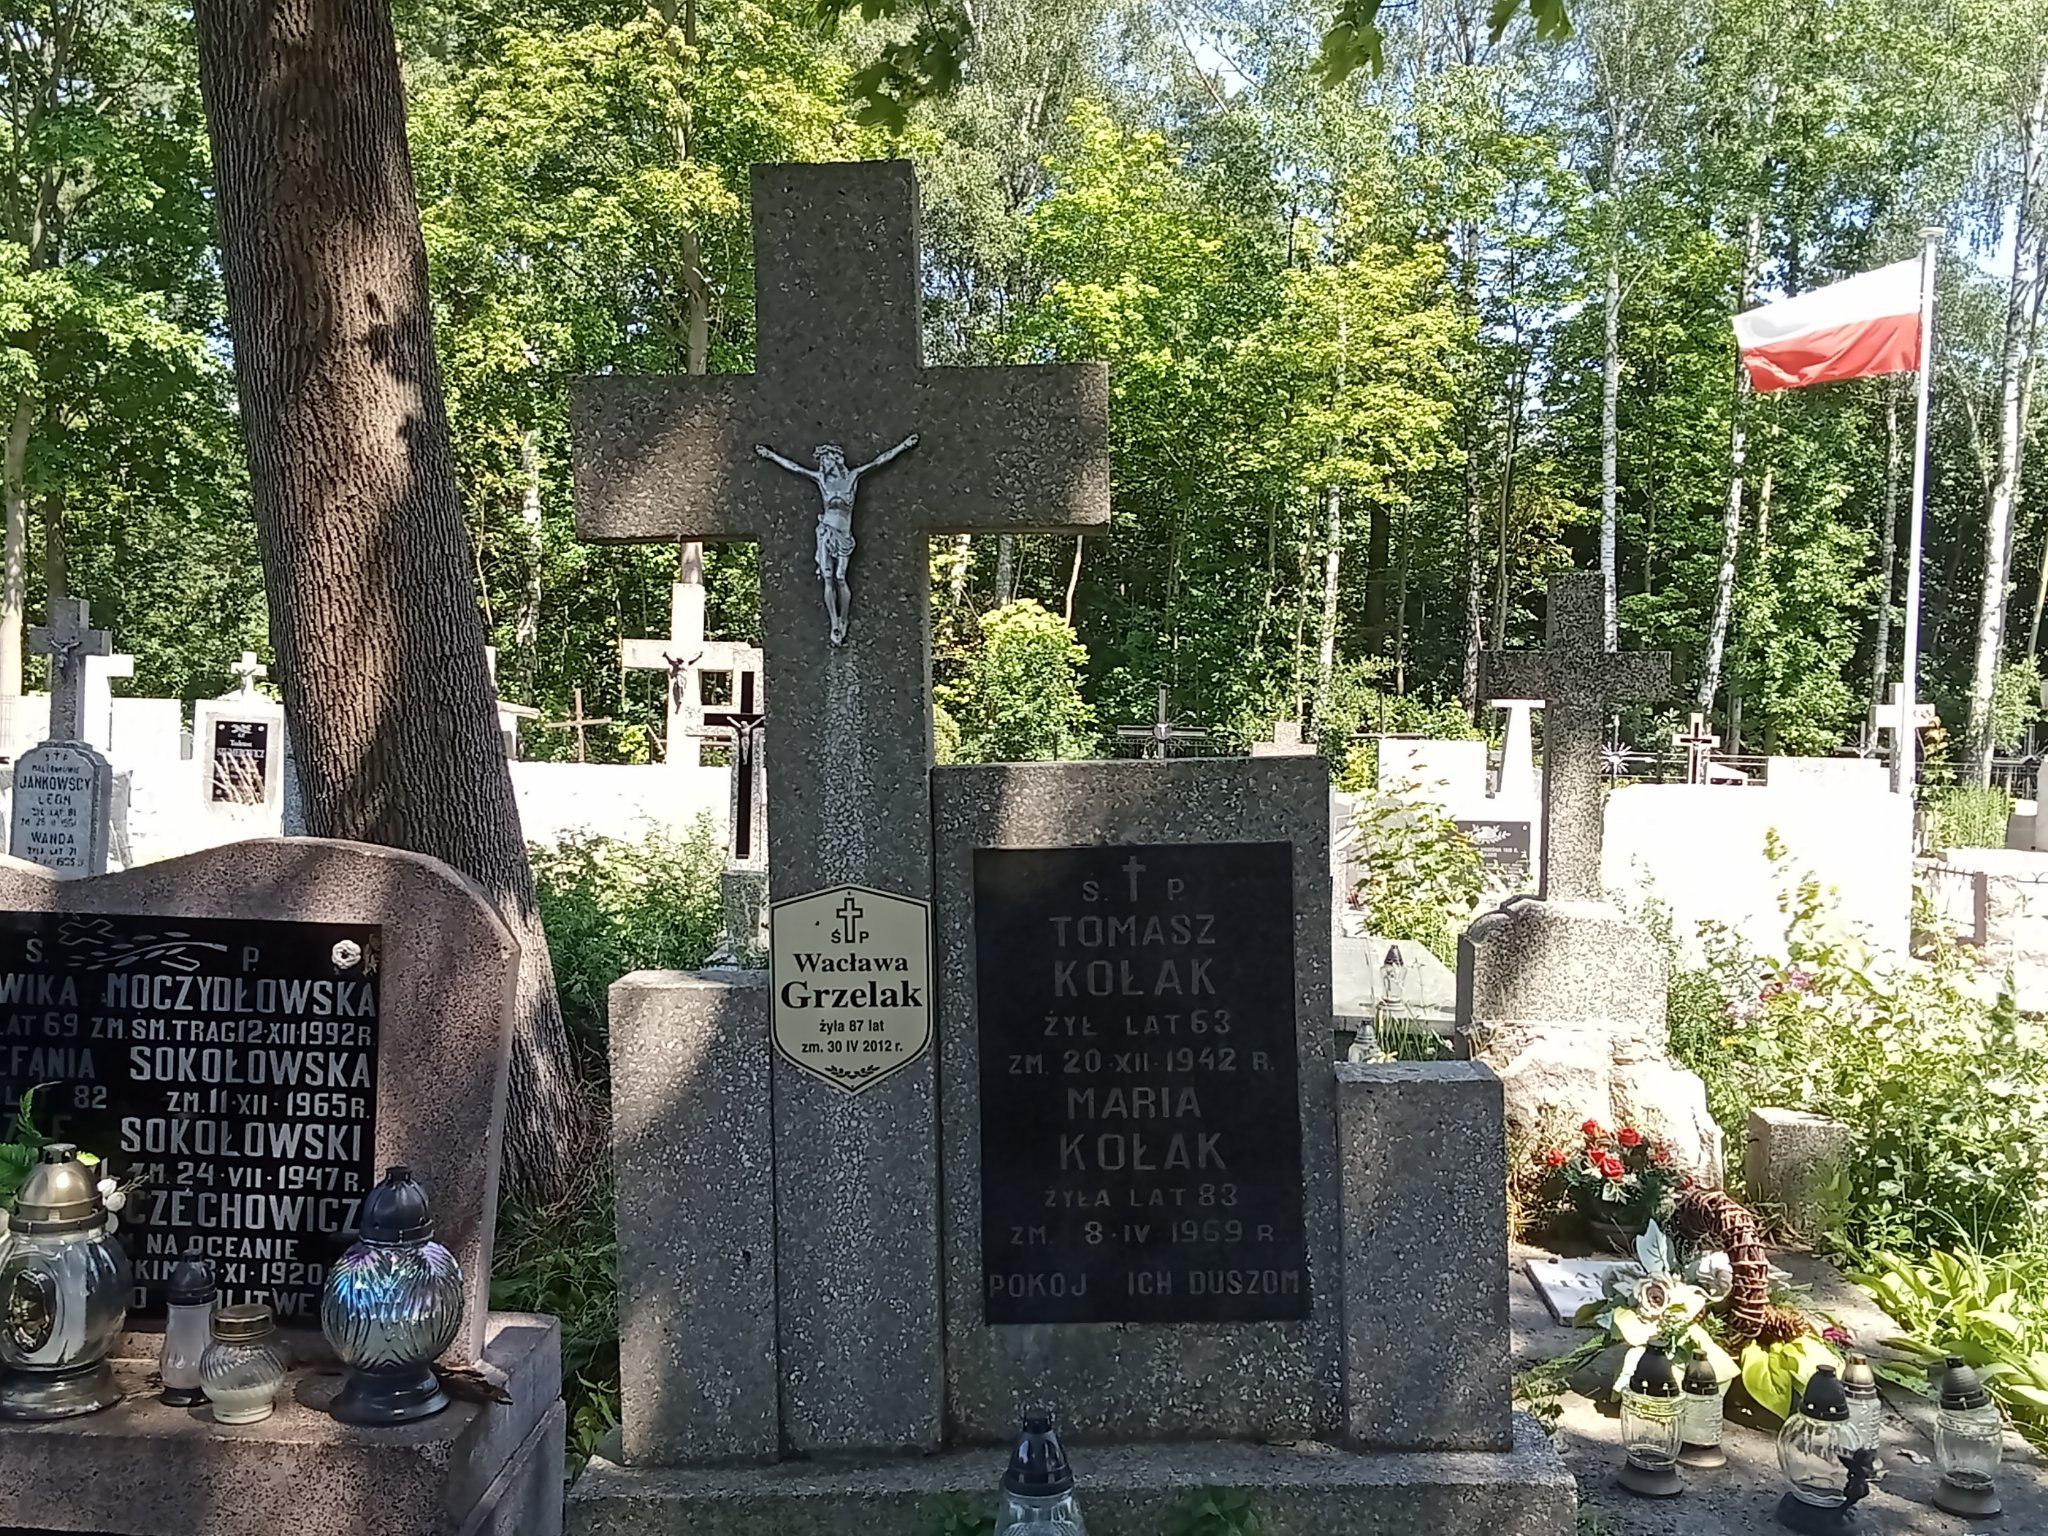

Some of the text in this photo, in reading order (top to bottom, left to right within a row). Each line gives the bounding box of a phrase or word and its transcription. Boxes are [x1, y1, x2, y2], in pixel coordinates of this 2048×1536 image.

[19, 775, 92, 791] JANKOWSCY
[38, 794, 71, 805] LEON
[31, 831, 74, 845] WANDA
[859, 931, 869, 943] P
[1049, 914, 1216, 947] TOMASZ
[793, 953, 908, 973] Wacława
[1054, 958, 1216, 997] KOŁAK
[106, 972, 376, 1018] MOCZYDŁOWSKA
[781, 980, 923, 1009] Grzelak
[0, 1013, 37, 1037] AT
[44, 1011, 78, 1037] 69
[849, 1019, 864, 1032] 87
[868, 1019, 885, 1032] lat
[1126, 1015, 1182, 1035] LAT
[1190, 1009, 1232, 1034] 63
[801, 1042, 824, 1053] zm.
[828, 1041, 842, 1053] 30
[846, 1040, 859, 1052] IV
[863, 1040, 892, 1052] 2012
[129, 1045, 372, 1089] SOKOŁOWSKA
[73, 1085, 108, 1110] 82
[1067, 1086, 1202, 1121] MARIA
[120, 1116, 362, 1162] SOKOŁOWSKI
[1059, 1132, 1227, 1171] KOŁAK
[1130, 1188, 1188, 1207] LAT
[1199, 1183, 1238, 1207] 83
[146, 1232, 179, 1256] NA
[187, 1235, 300, 1262] OCEANIE
[1128, 1271, 1172, 1298] ICH
[1188, 1268, 1300, 1297] DUSZOM
